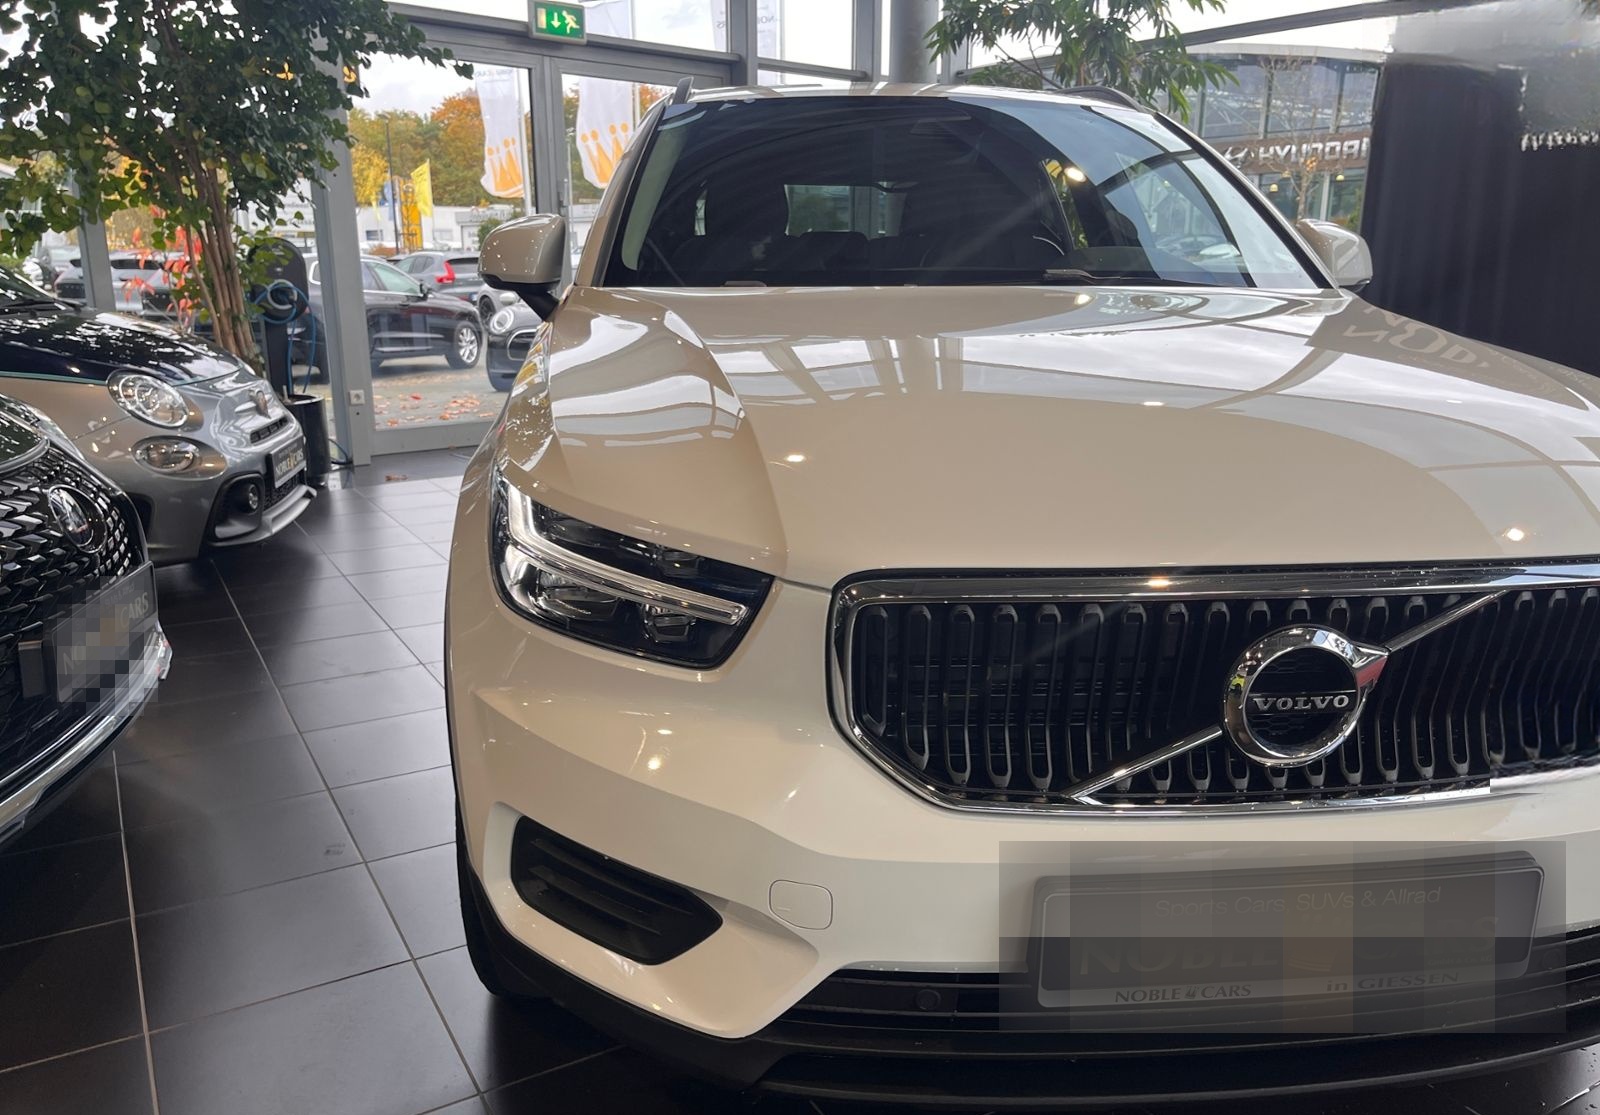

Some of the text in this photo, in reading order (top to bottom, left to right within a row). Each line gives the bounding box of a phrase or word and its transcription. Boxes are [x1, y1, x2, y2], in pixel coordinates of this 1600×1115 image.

[1259, 138, 1370, 163] HYUNDAI
[120, 592, 149, 628] CARS
[1253, 694, 1349, 711] VOLVO
[1155, 886, 1441, 920] Sports Cars, SUVs & Allrad
[1115, 972, 1459, 1002] NOBLE CARS in GIESSEN
